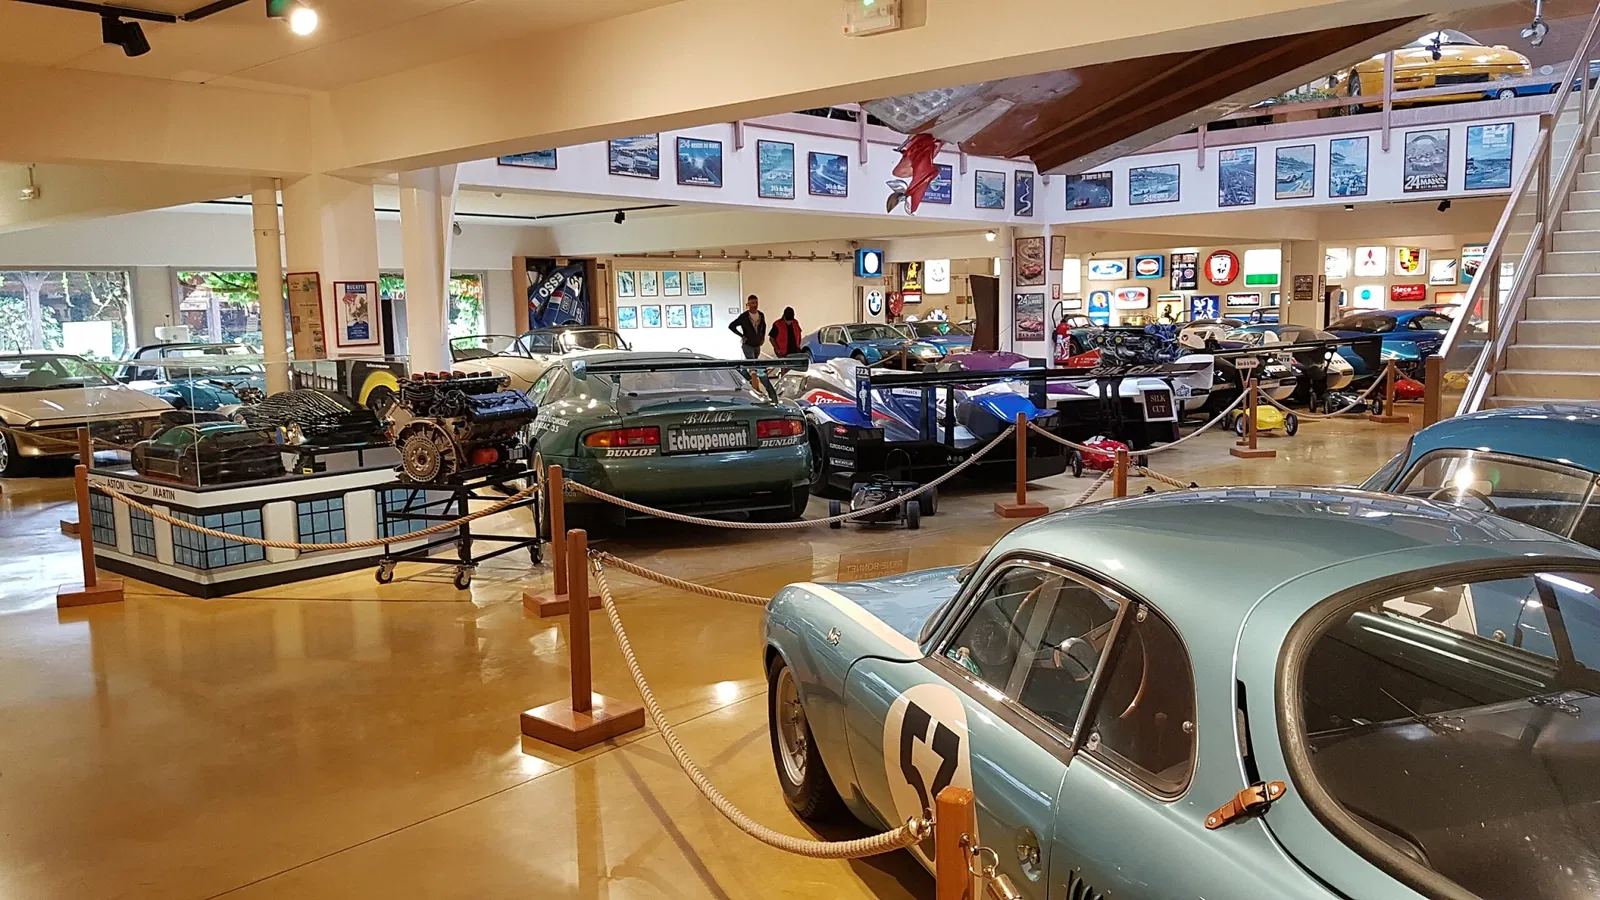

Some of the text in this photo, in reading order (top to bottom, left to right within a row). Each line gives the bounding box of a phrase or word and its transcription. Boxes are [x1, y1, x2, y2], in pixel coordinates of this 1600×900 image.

[680, 140, 690, 148] 24
[1296, 180, 1311, 192] 24
[1404, 175, 1421, 190] 24
[1421, 178, 1447, 186] MANS
[1028, 238, 1041, 247] 24
[538, 272, 564, 298] ESSO
[1017, 294, 1029, 304] 24
[814, 395, 842, 405] TOT
[1150, 394, 1166, 402] SILK
[1152, 405, 1166, 413] CUT
[668, 428, 747, 451] Echappement
[760, 437, 798, 448] DUNLOP
[605, 448, 657, 457] DUNLOP
[107, 479, 176, 501] ASTON MARTIN
